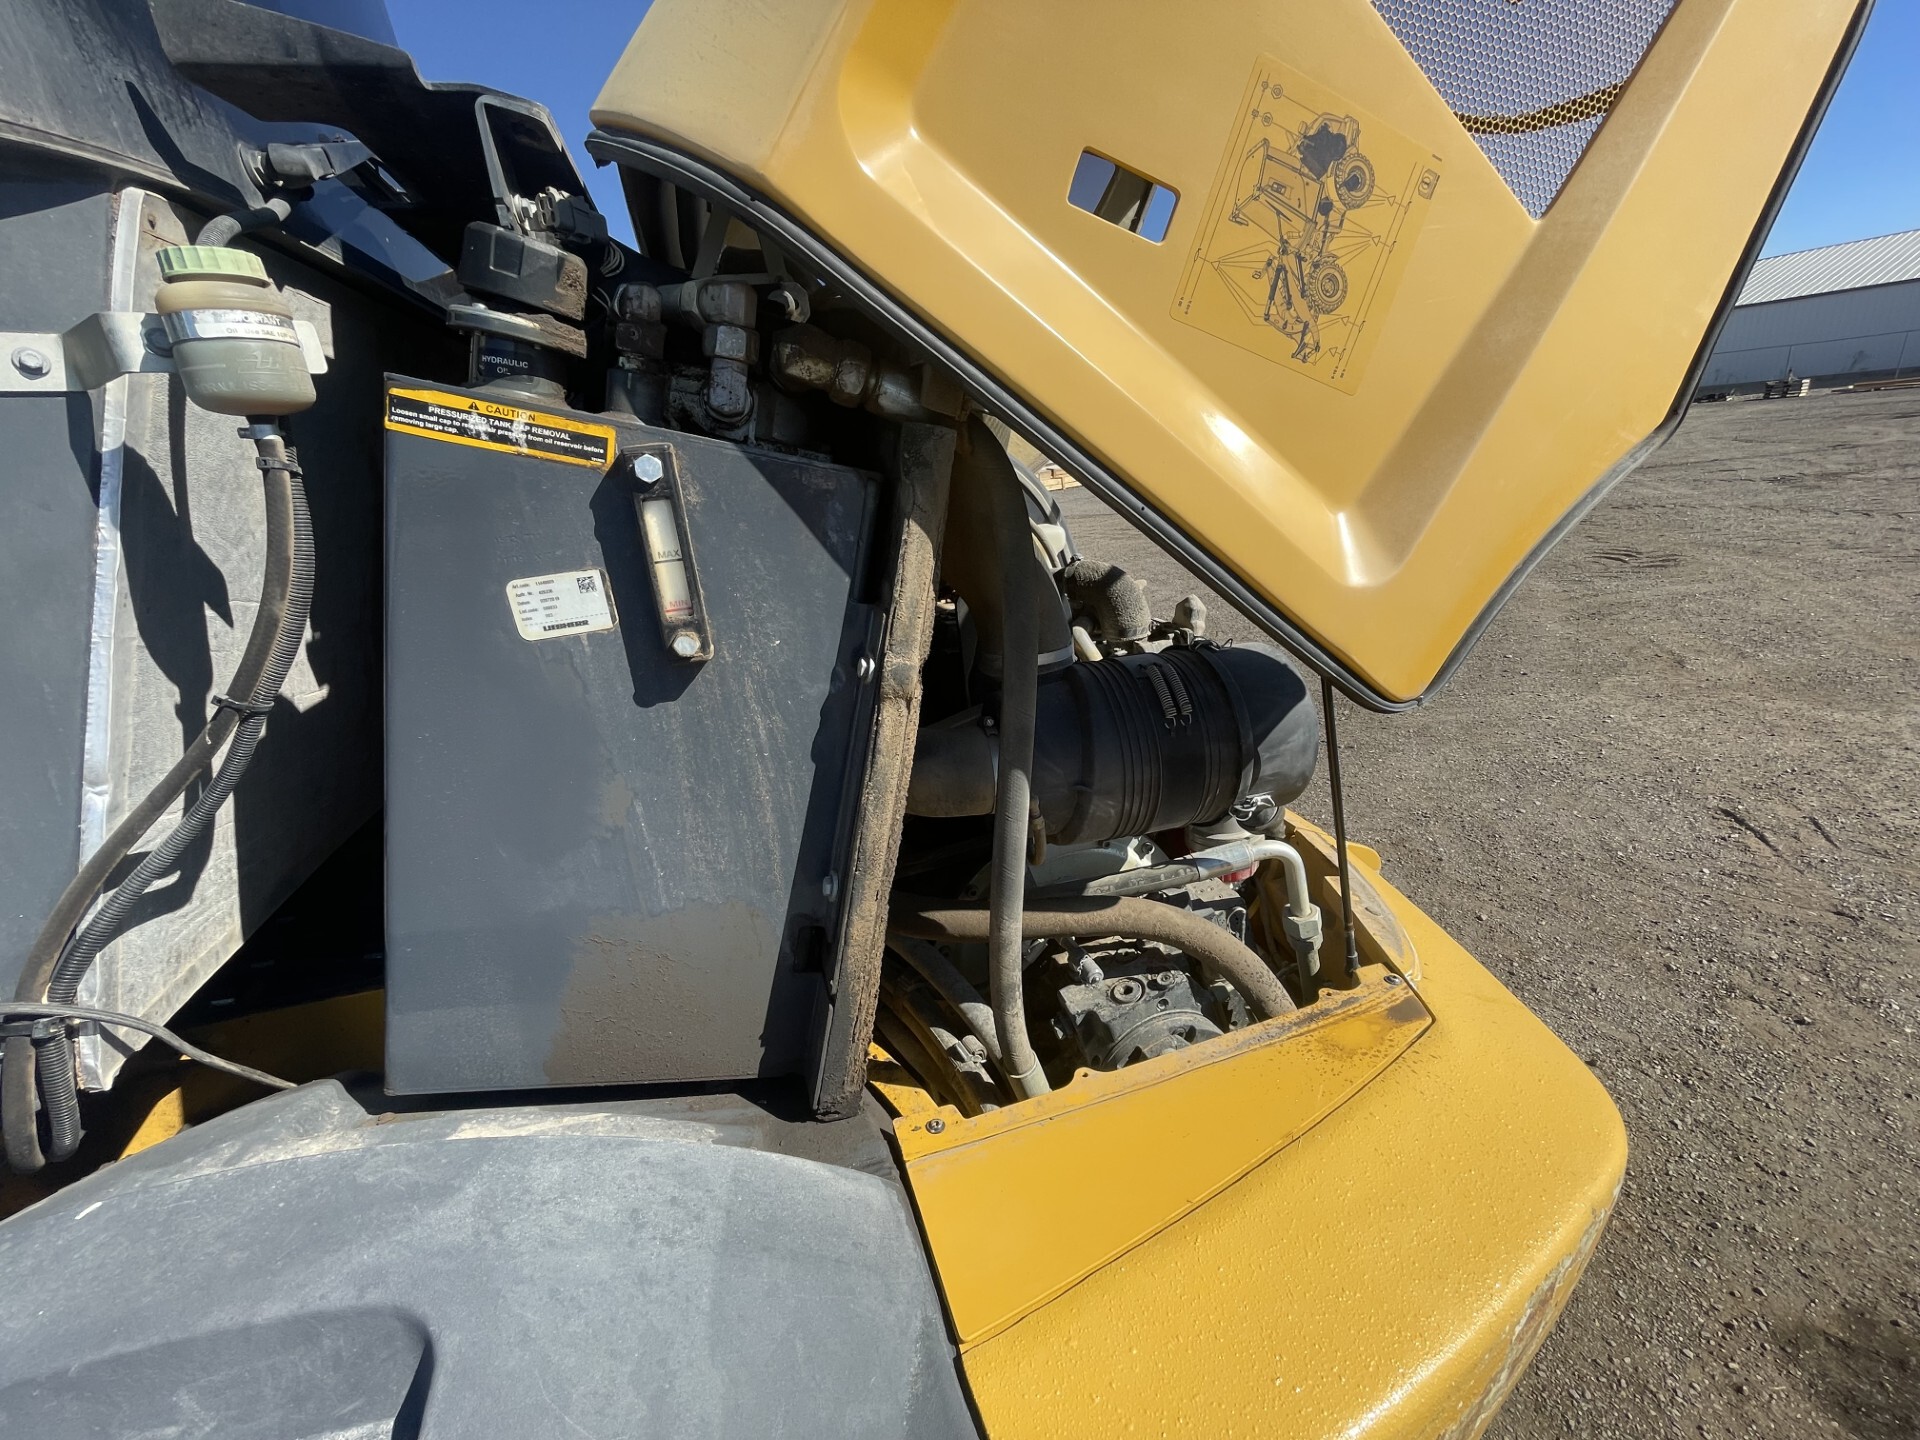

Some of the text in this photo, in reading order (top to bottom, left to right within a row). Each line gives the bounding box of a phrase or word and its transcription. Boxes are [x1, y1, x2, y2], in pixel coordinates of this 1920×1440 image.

[481, 354, 529, 369] HYDRAULIC
[496, 366, 511, 375] OIL
[485, 404, 536, 422] CAUTION
[391, 415, 459, 434] removing large cap.
[391, 406, 418, 417] Loosen
[419, 413, 438, 422] small
[527, 434, 543, 442] from
[553, 440, 583, 450] reservoir
[583, 444, 604, 453] before
[428, 406, 571, 441] PRESSURIZED TANK CAP REMOVAL
[657, 548, 681, 559] MAX
[669, 599, 688, 608] MIN
[543, 620, 589, 631] LIEBHERR
